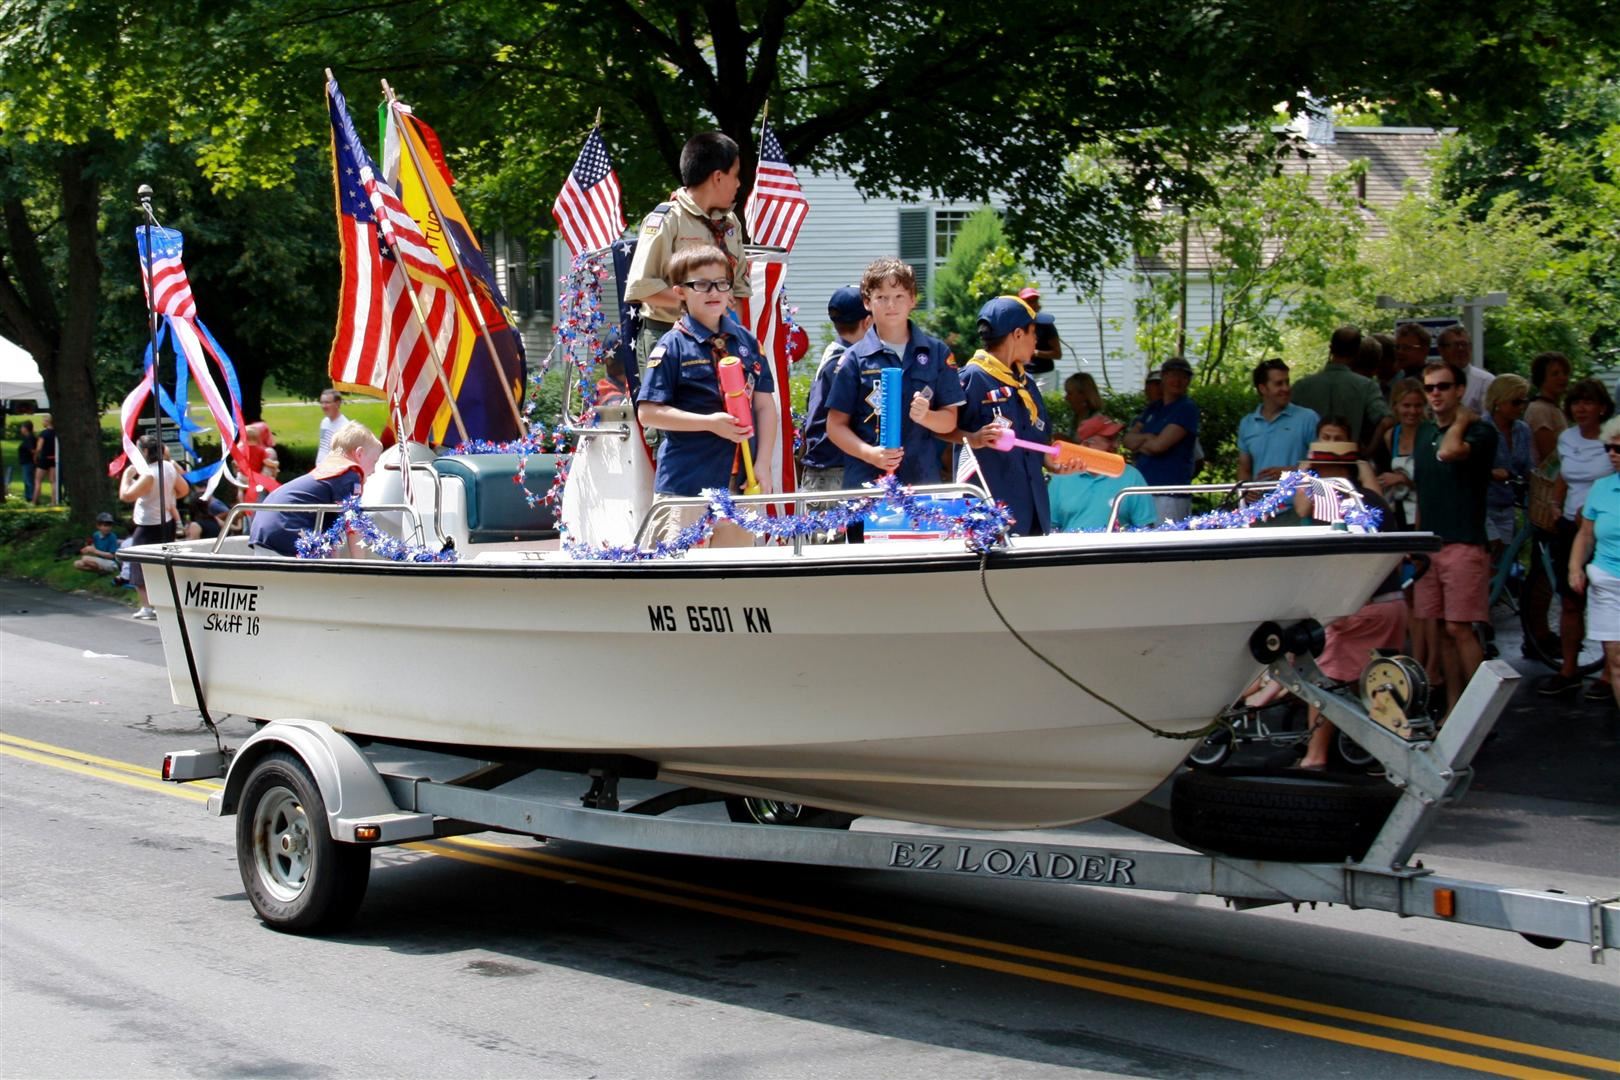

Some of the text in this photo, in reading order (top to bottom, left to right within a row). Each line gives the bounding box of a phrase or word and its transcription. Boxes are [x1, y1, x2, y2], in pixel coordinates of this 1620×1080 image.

[185, 581, 259, 611] MARITIME
[203, 613, 260, 636] Skiff 16
[648, 605, 772, 633] MS 6501 KN
[888, 841, 1136, 885] EZ LOADER
